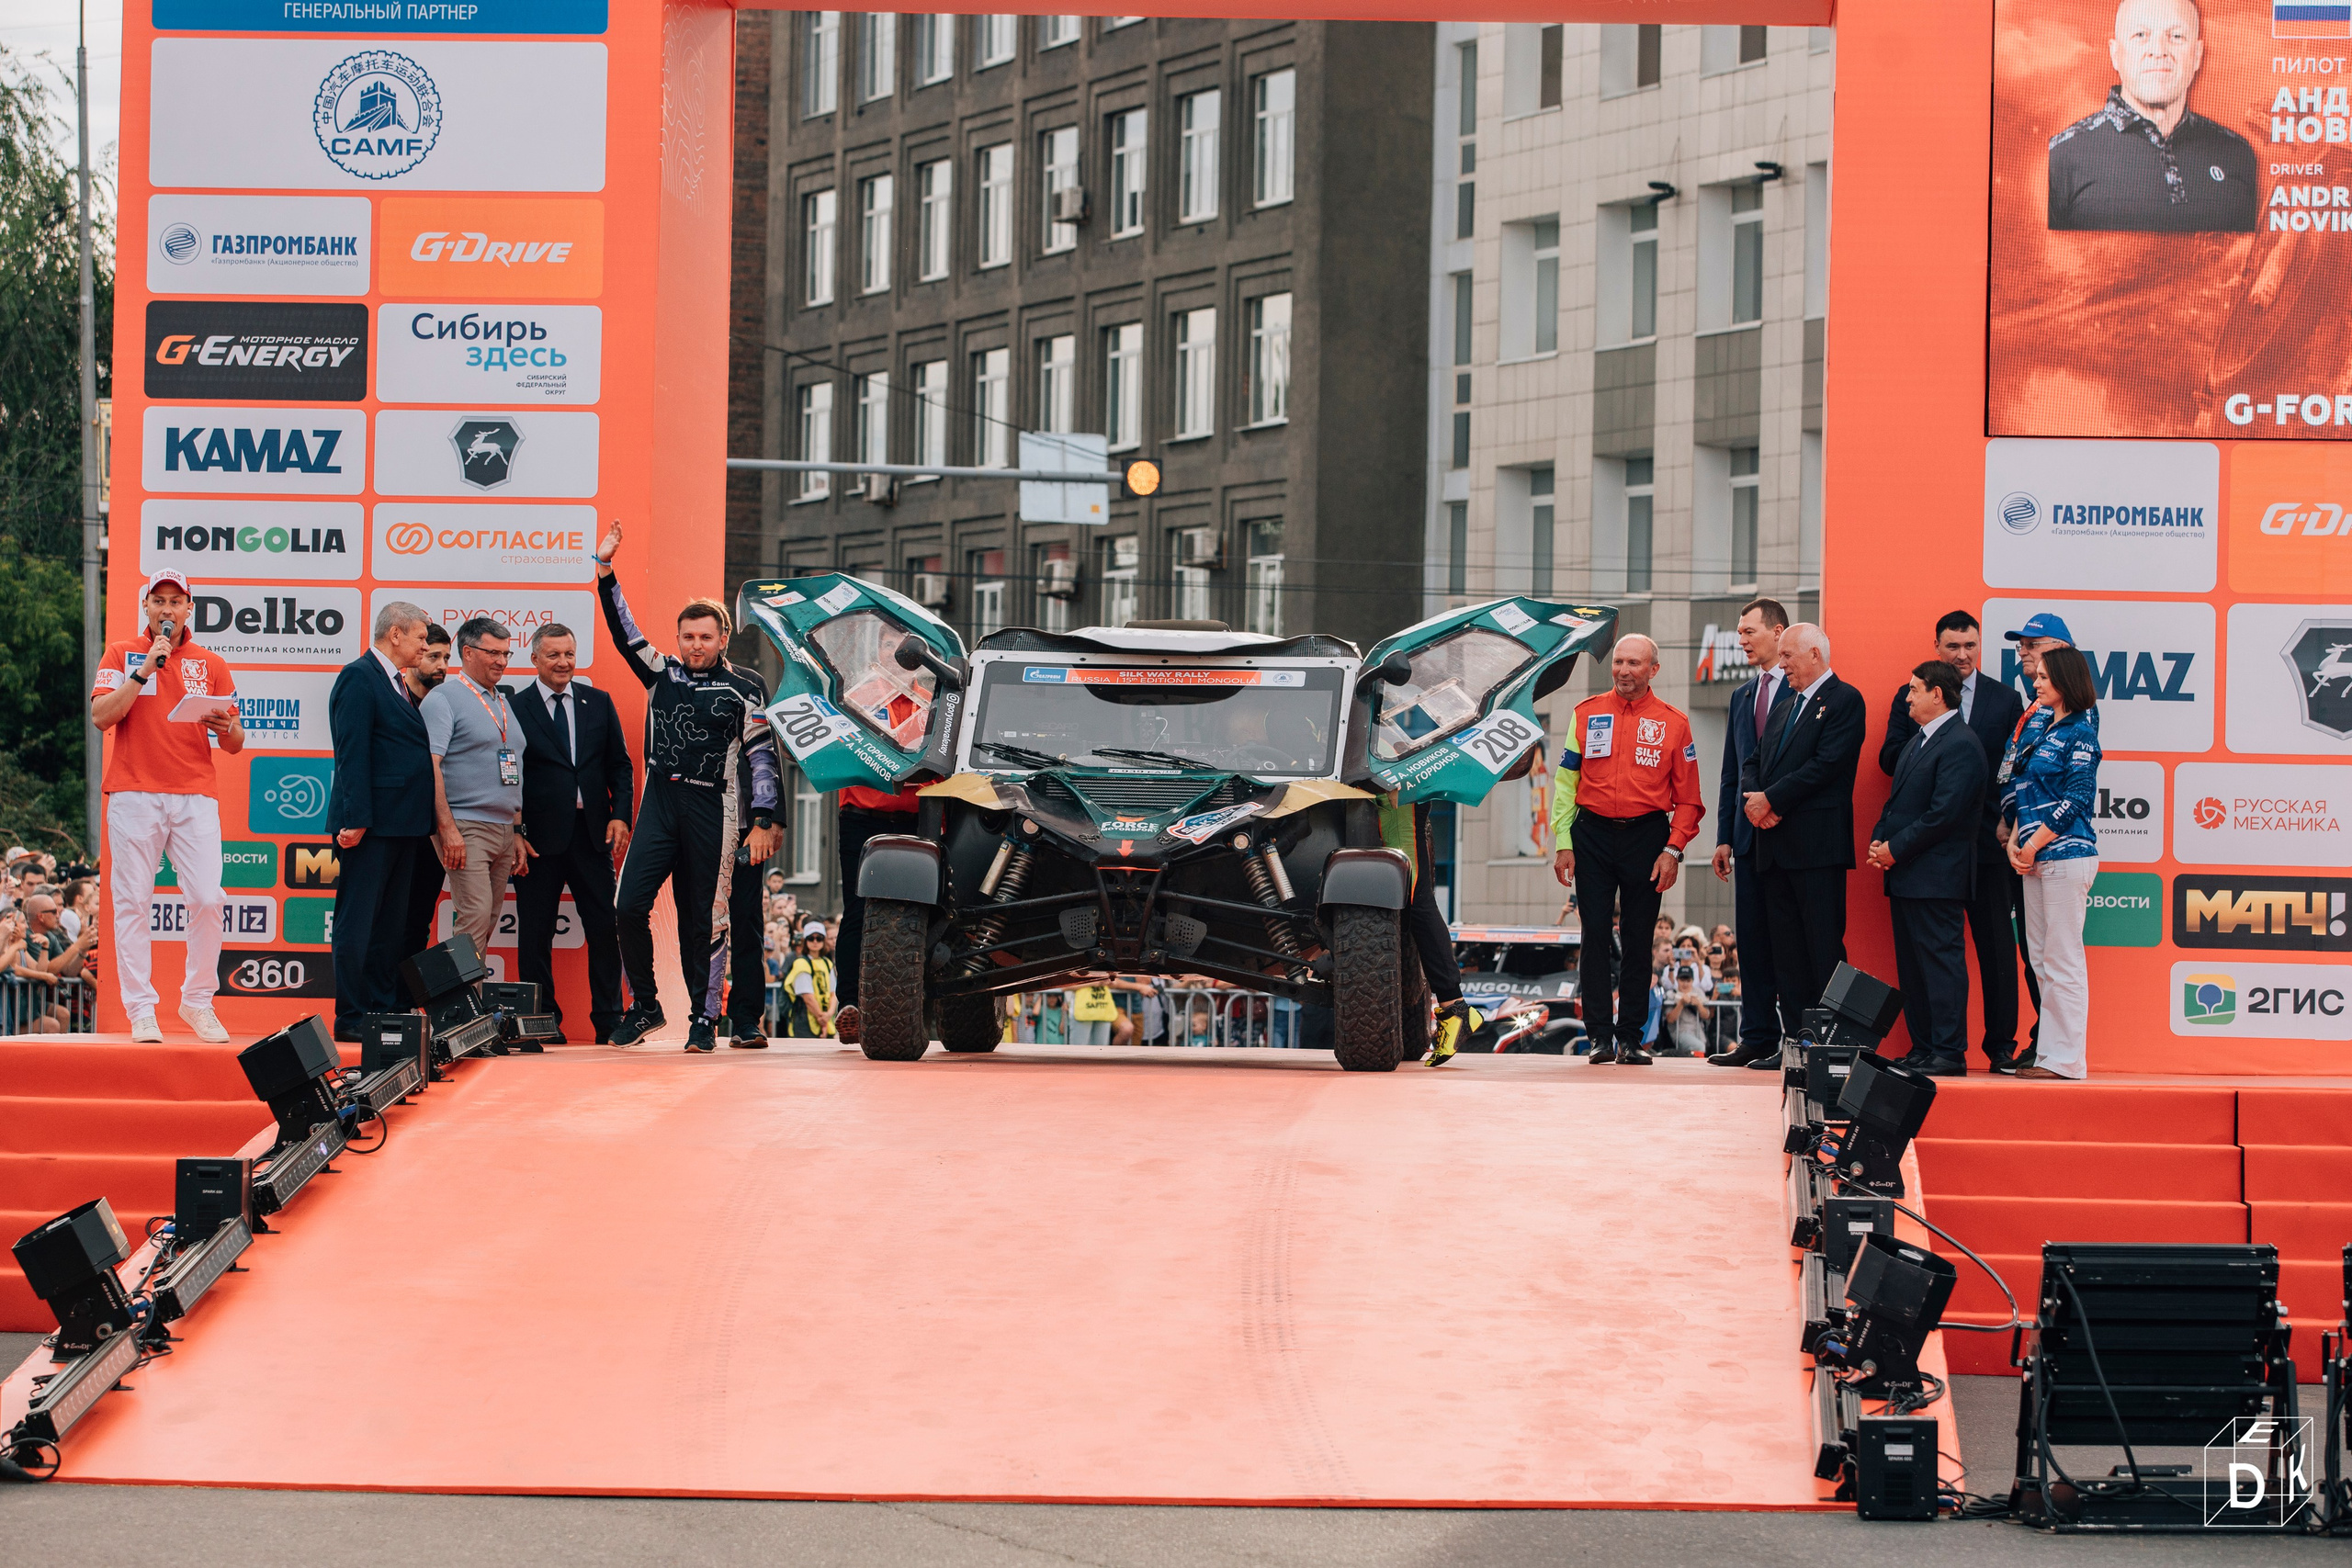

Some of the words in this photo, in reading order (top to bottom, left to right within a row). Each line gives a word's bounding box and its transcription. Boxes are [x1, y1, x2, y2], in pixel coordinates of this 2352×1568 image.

[283, 1, 401, 19] ГЕНЕРАЛЬНЫЙ
[407, 4, 478, 21] ПАРТНЕР
[2272, 57, 2346, 73] ПИЛОТ
[2271, 117, 2352, 143] НОВ
[331, 137, 424, 156] CAMF
[2270, 164, 2324, 175] DRIVER
[2269, 186, 2351, 208] ANDR
[212, 233, 357, 256] ГАЗПРОМБАНК
[211, 257, 266, 266] «Газпромбанк»
[267, 258, 319, 267] (Акционерное
[321, 259, 359, 268] общество)
[412, 313, 548, 347] Сибирь
[240, 336, 311, 344] МОТОРНОЕ
[313, 337, 359, 345] МАСЛО
[466, 346, 567, 371] здесь
[516, 381, 567, 389] ФЕДЕРАЛЬНЫЙ
[526, 373, 567, 381] СИБИРСКИЙ
[164, 428, 343, 474] KAMAZ
[2052, 504, 2204, 527] ГАЗПРОМБАНК
[157, 525, 346, 553] MONGOLIA
[437, 529, 583, 550] СОГЛАСИЕ
[2051, 528, 2109, 537] «Газпромбанк»
[2109, 529, 2164, 538] (Акционерное
[2165, 530, 2205, 539] общество)
[501, 554, 583, 568] страхование
[193, 596, 345, 636] Delko
[282, 647, 342, 655] КОМПАНИЯ
[184, 681, 207, 689] SILK
[185, 687, 208, 695] WAY
[239, 698, 300, 717] АЗПРОМ
[243, 719, 298, 728] ОБЫЧА
[775, 702, 831, 749] 208
[251, 731, 300, 739] КУТСК
[1472, 718, 1531, 764] 208
[863, 741, 900, 773] ГОРЮНОВ
[1408, 747, 1449, 773] НОВИКОВ
[1635, 747, 1661, 759] SILK
[1635, 755, 1660, 768] WAY
[854, 749, 892, 782] НОВИКОВ
[1416, 751, 1460, 784] ГОРЮНОВ
[2233, 798, 2327, 815] РУССКАЯ
[2098, 828, 2149, 836] КОМПАНИЯ
[2233, 816, 2340, 832] МЕХАНИКА
[2186, 889, 2346, 936] МАТЧ!
[241, 959, 305, 989] 360
[2247, 987, 2345, 1017] 2ГИС
